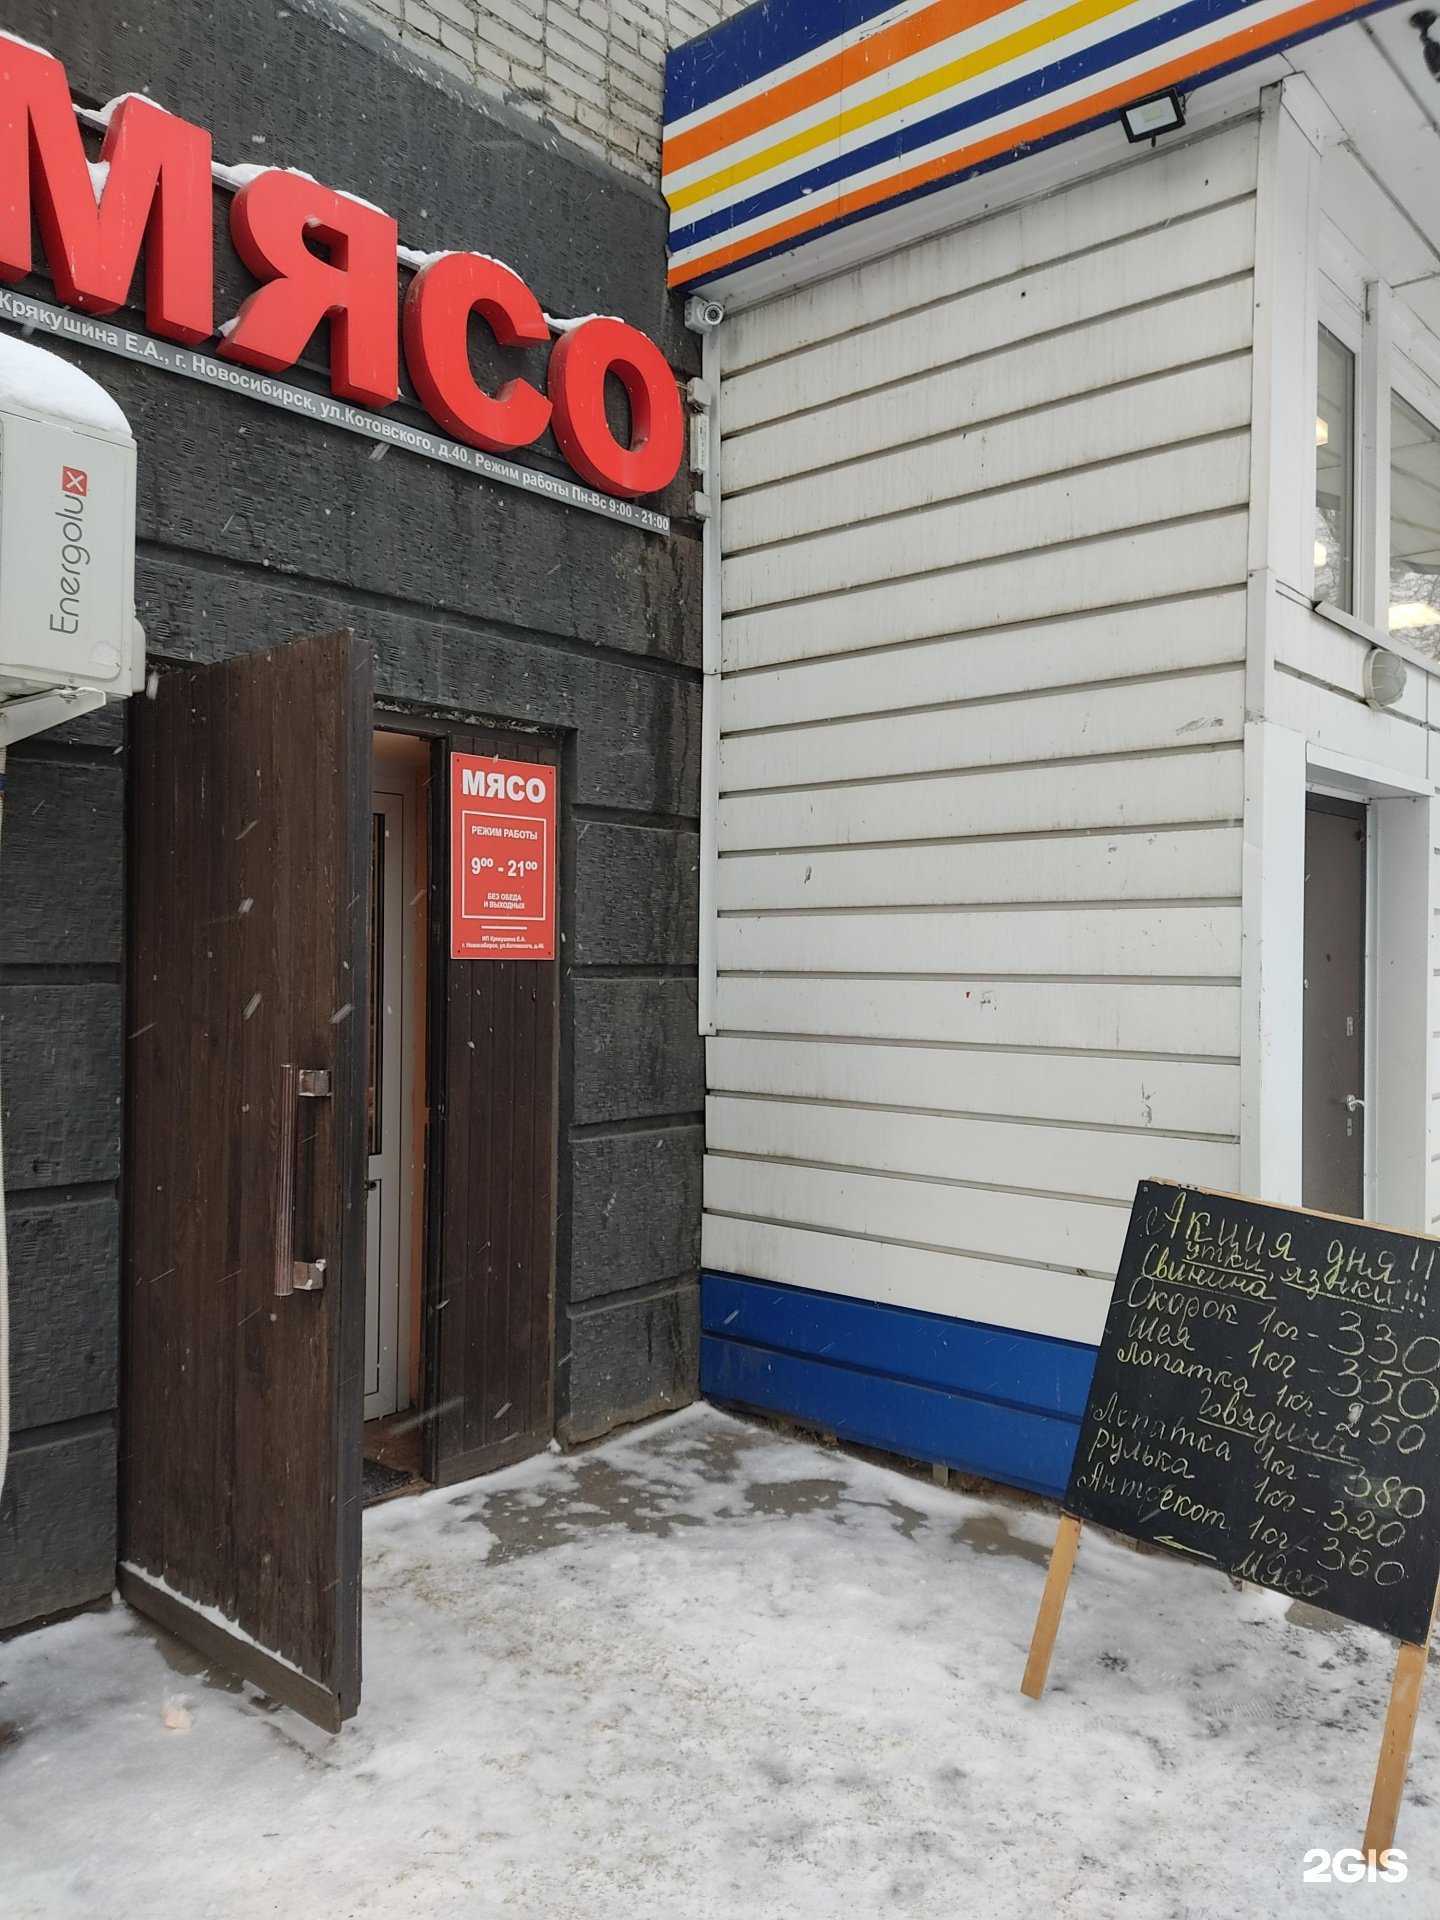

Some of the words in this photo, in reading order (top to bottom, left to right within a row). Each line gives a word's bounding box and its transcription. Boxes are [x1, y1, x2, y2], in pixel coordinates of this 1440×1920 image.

[0, 30, 684, 497] МЯСО
[0, 290, 118, 347] Крякушина
[175, 353, 188, 369] г.
[192, 354, 317, 413] Новосибирск,
[475, 452, 520, 482] Режим
[522, 470, 570, 498] работы
[571, 485, 607, 511] Пн-Вс
[608, 499, 633, 519] 9:00
[640, 508, 670, 531] 21:00
[49, 465, 91, 634] Energolux
[461, 768, 546, 804] МЯСО
[471, 825, 502, 838] РЕЖИМ
[503, 827, 538, 841] РАБОТЫ
[487, 892, 500, 901] БЕЗ
[1147, 1191, 1297, 1262] Акция
[1141, 1243, 1278, 1301] Свинина
[1127, 1275, 1239, 1330] Окорок
[1327, 1310, 1440, 1374] 330
[1116, 1341, 1256, 1398] Лопатка
[1327, 1358, 1439, 1420] 350
[1343, 1463, 1426, 1519] 380
[1322, 1500, 1406, 1547] 320
[1315, 1536, 1405, 1586] 360
